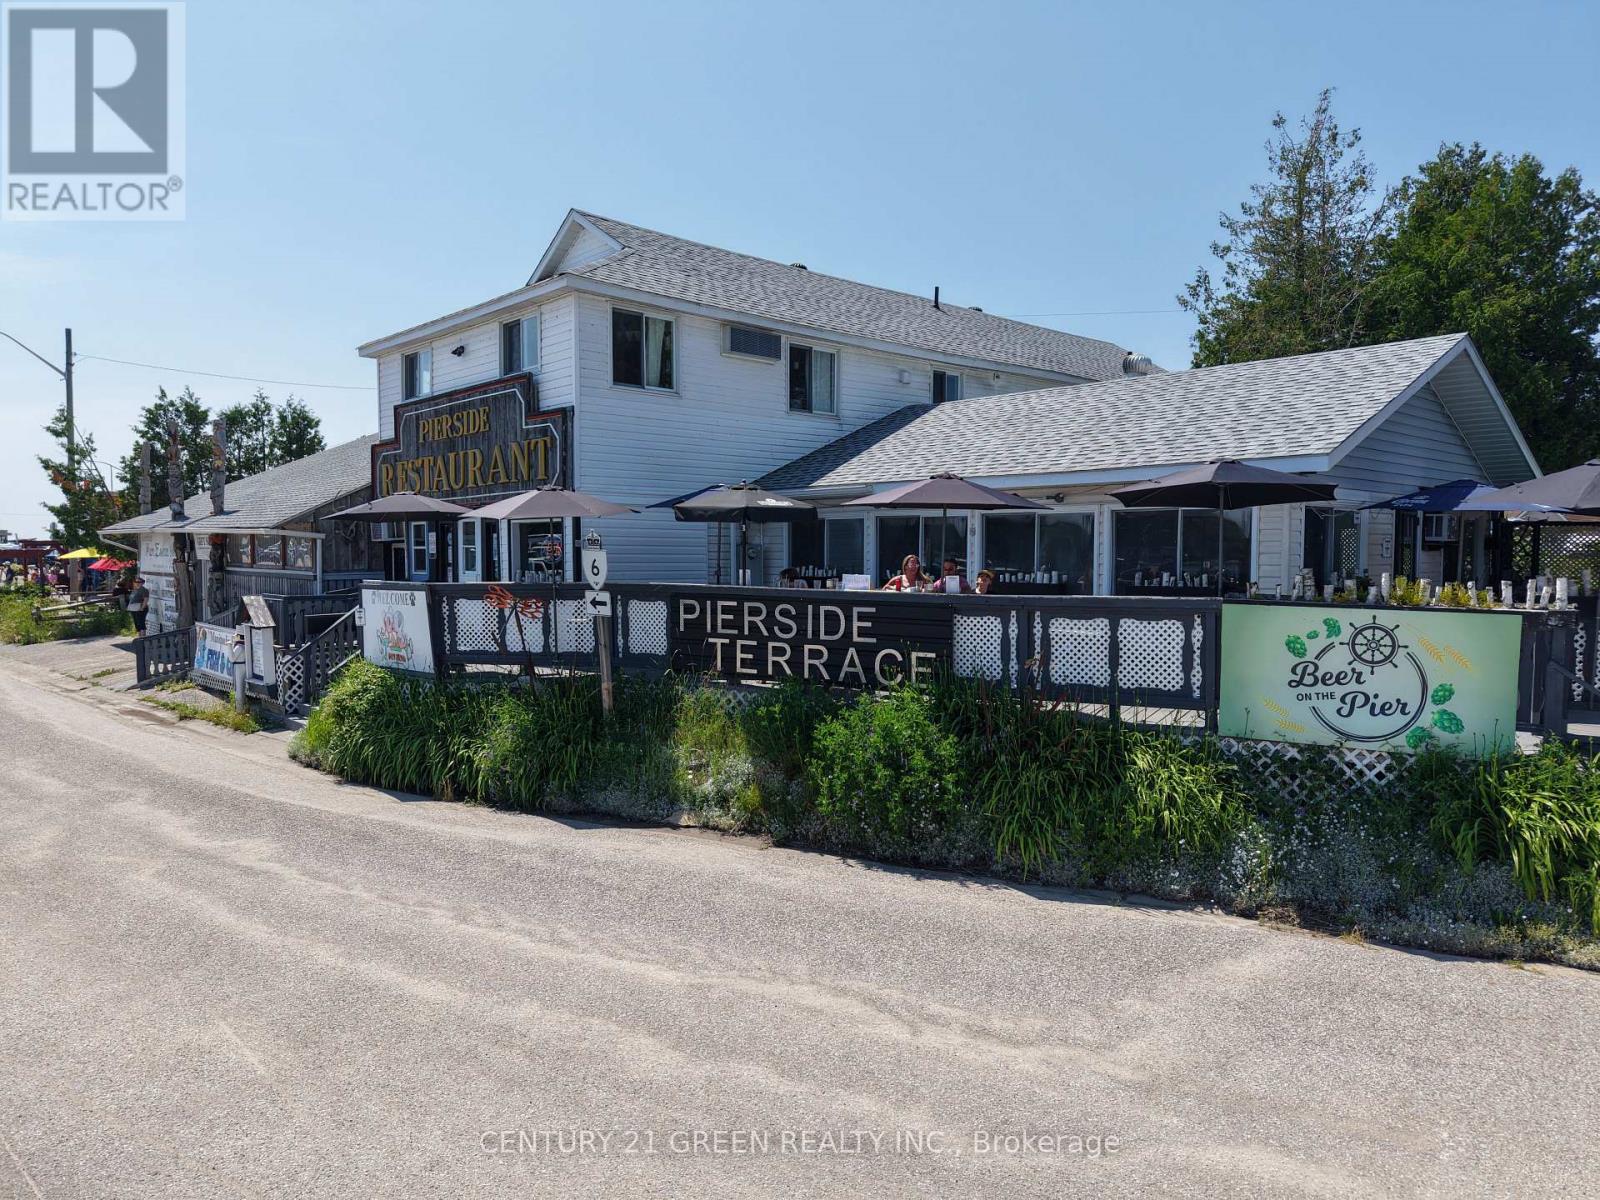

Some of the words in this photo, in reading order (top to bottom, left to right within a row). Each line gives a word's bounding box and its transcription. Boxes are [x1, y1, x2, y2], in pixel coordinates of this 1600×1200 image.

[419, 406, 491, 444] PIERSIDE
[381, 436, 553, 498] RESTAURANT
[591, 558, 600, 577] 6
[377, 591, 409, 606] WELCOME
[679, 599, 877, 644] PIERSIDE
[708, 637, 937, 690] TERRACE
[1287, 660, 1367, 688] Beer
[1296, 692, 1312, 701] ON
[1314, 691, 1336, 700] THE
[1336, 690, 1411, 718] Pier
